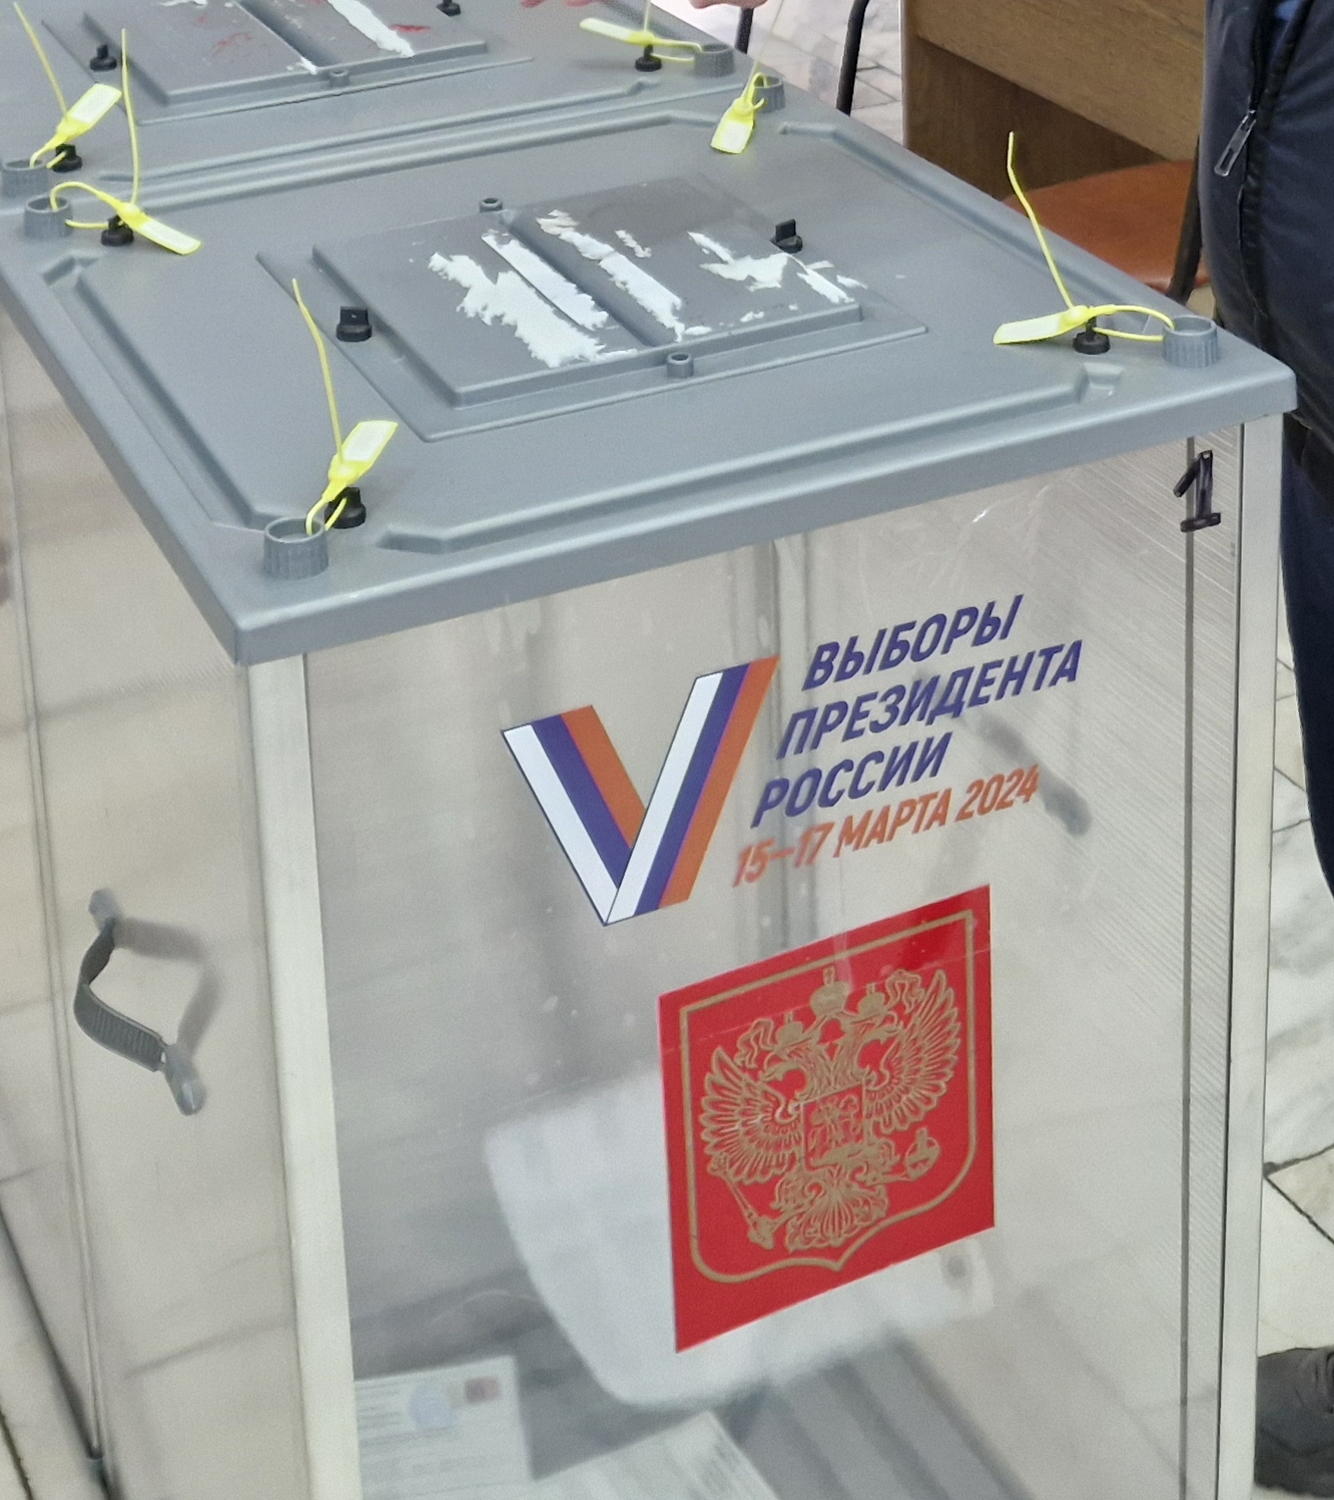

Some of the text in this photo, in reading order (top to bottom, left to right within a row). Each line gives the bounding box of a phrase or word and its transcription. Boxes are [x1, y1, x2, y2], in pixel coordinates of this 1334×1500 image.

[1172, 449, 1222, 533] 1
[801, 593, 1024, 692] ВЫБОРЫ
[776, 639, 1083, 760] ПРЕЗИДЕНТА
[750, 731, 954, 830] РОССИИ
[833, 787, 953, 859] МАРТА
[954, 763, 1041, 823] 2024
